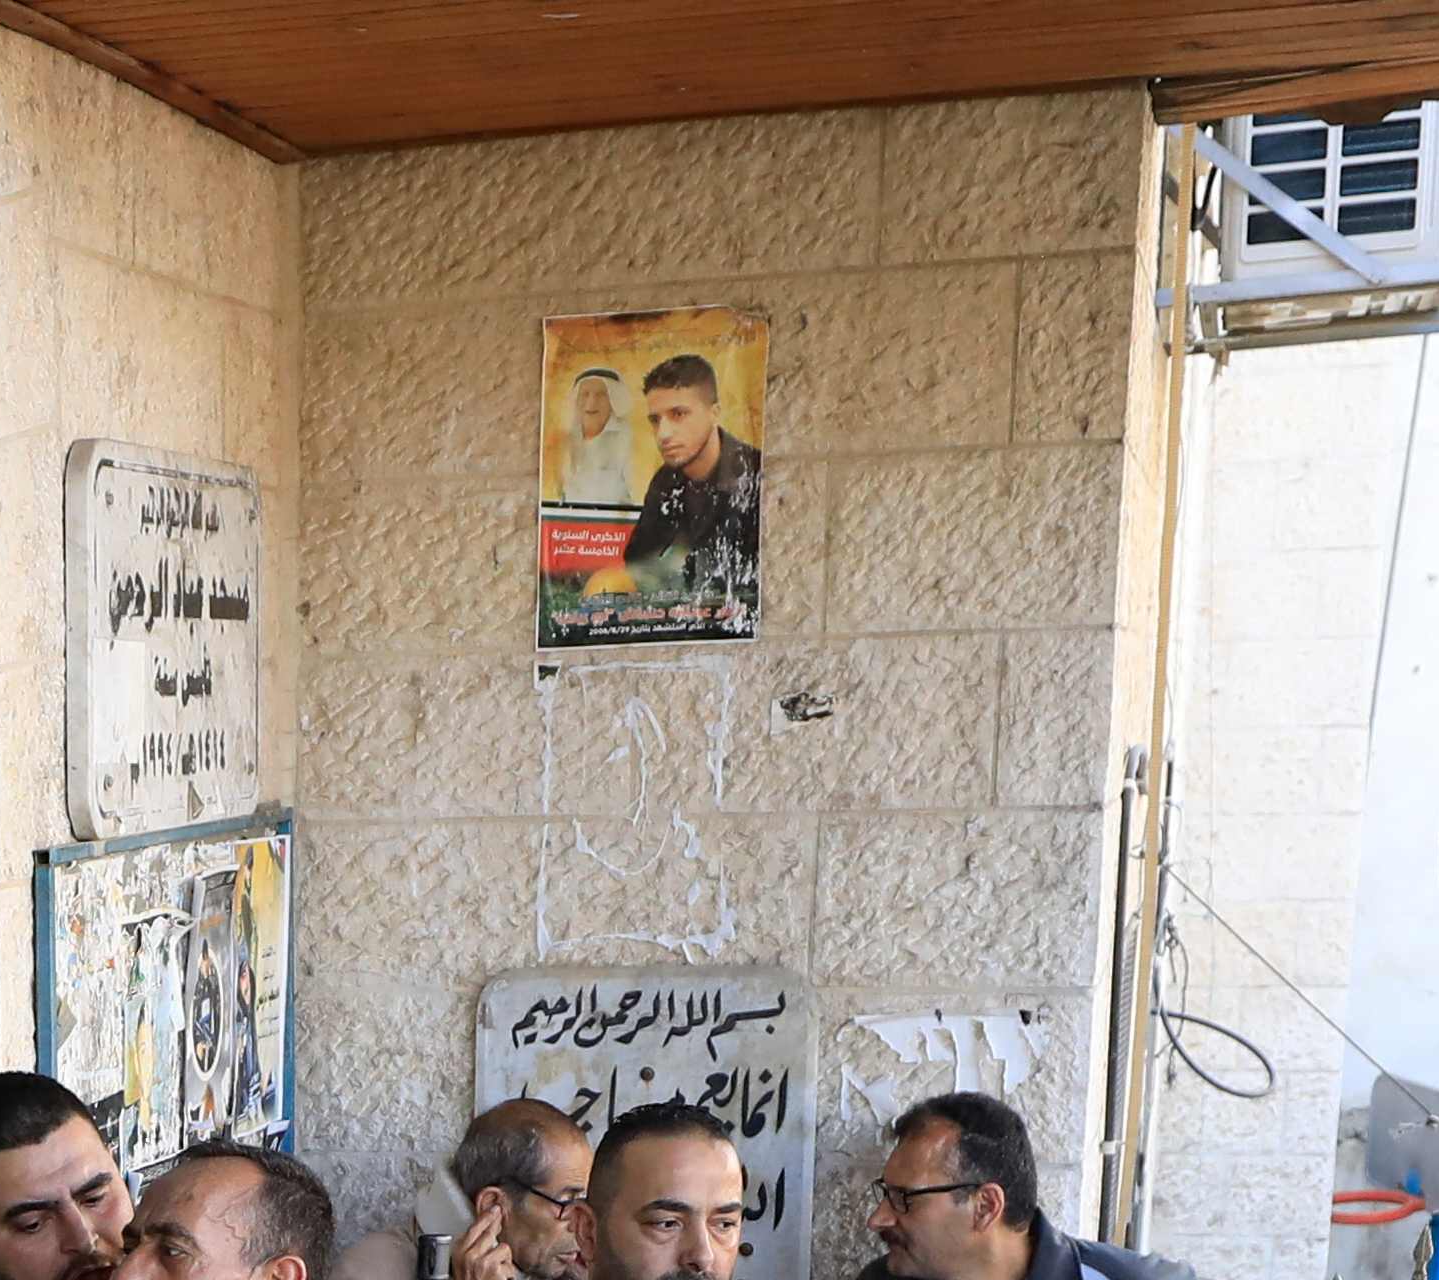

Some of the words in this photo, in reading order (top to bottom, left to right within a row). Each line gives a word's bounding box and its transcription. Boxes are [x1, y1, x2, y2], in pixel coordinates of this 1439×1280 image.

[511, 984, 598, 1050] الرحيم
[573, 988, 675, 1048] الرحمن
[662, 988, 721, 1048] الله
[706, 990, 787, 1062] بسم
